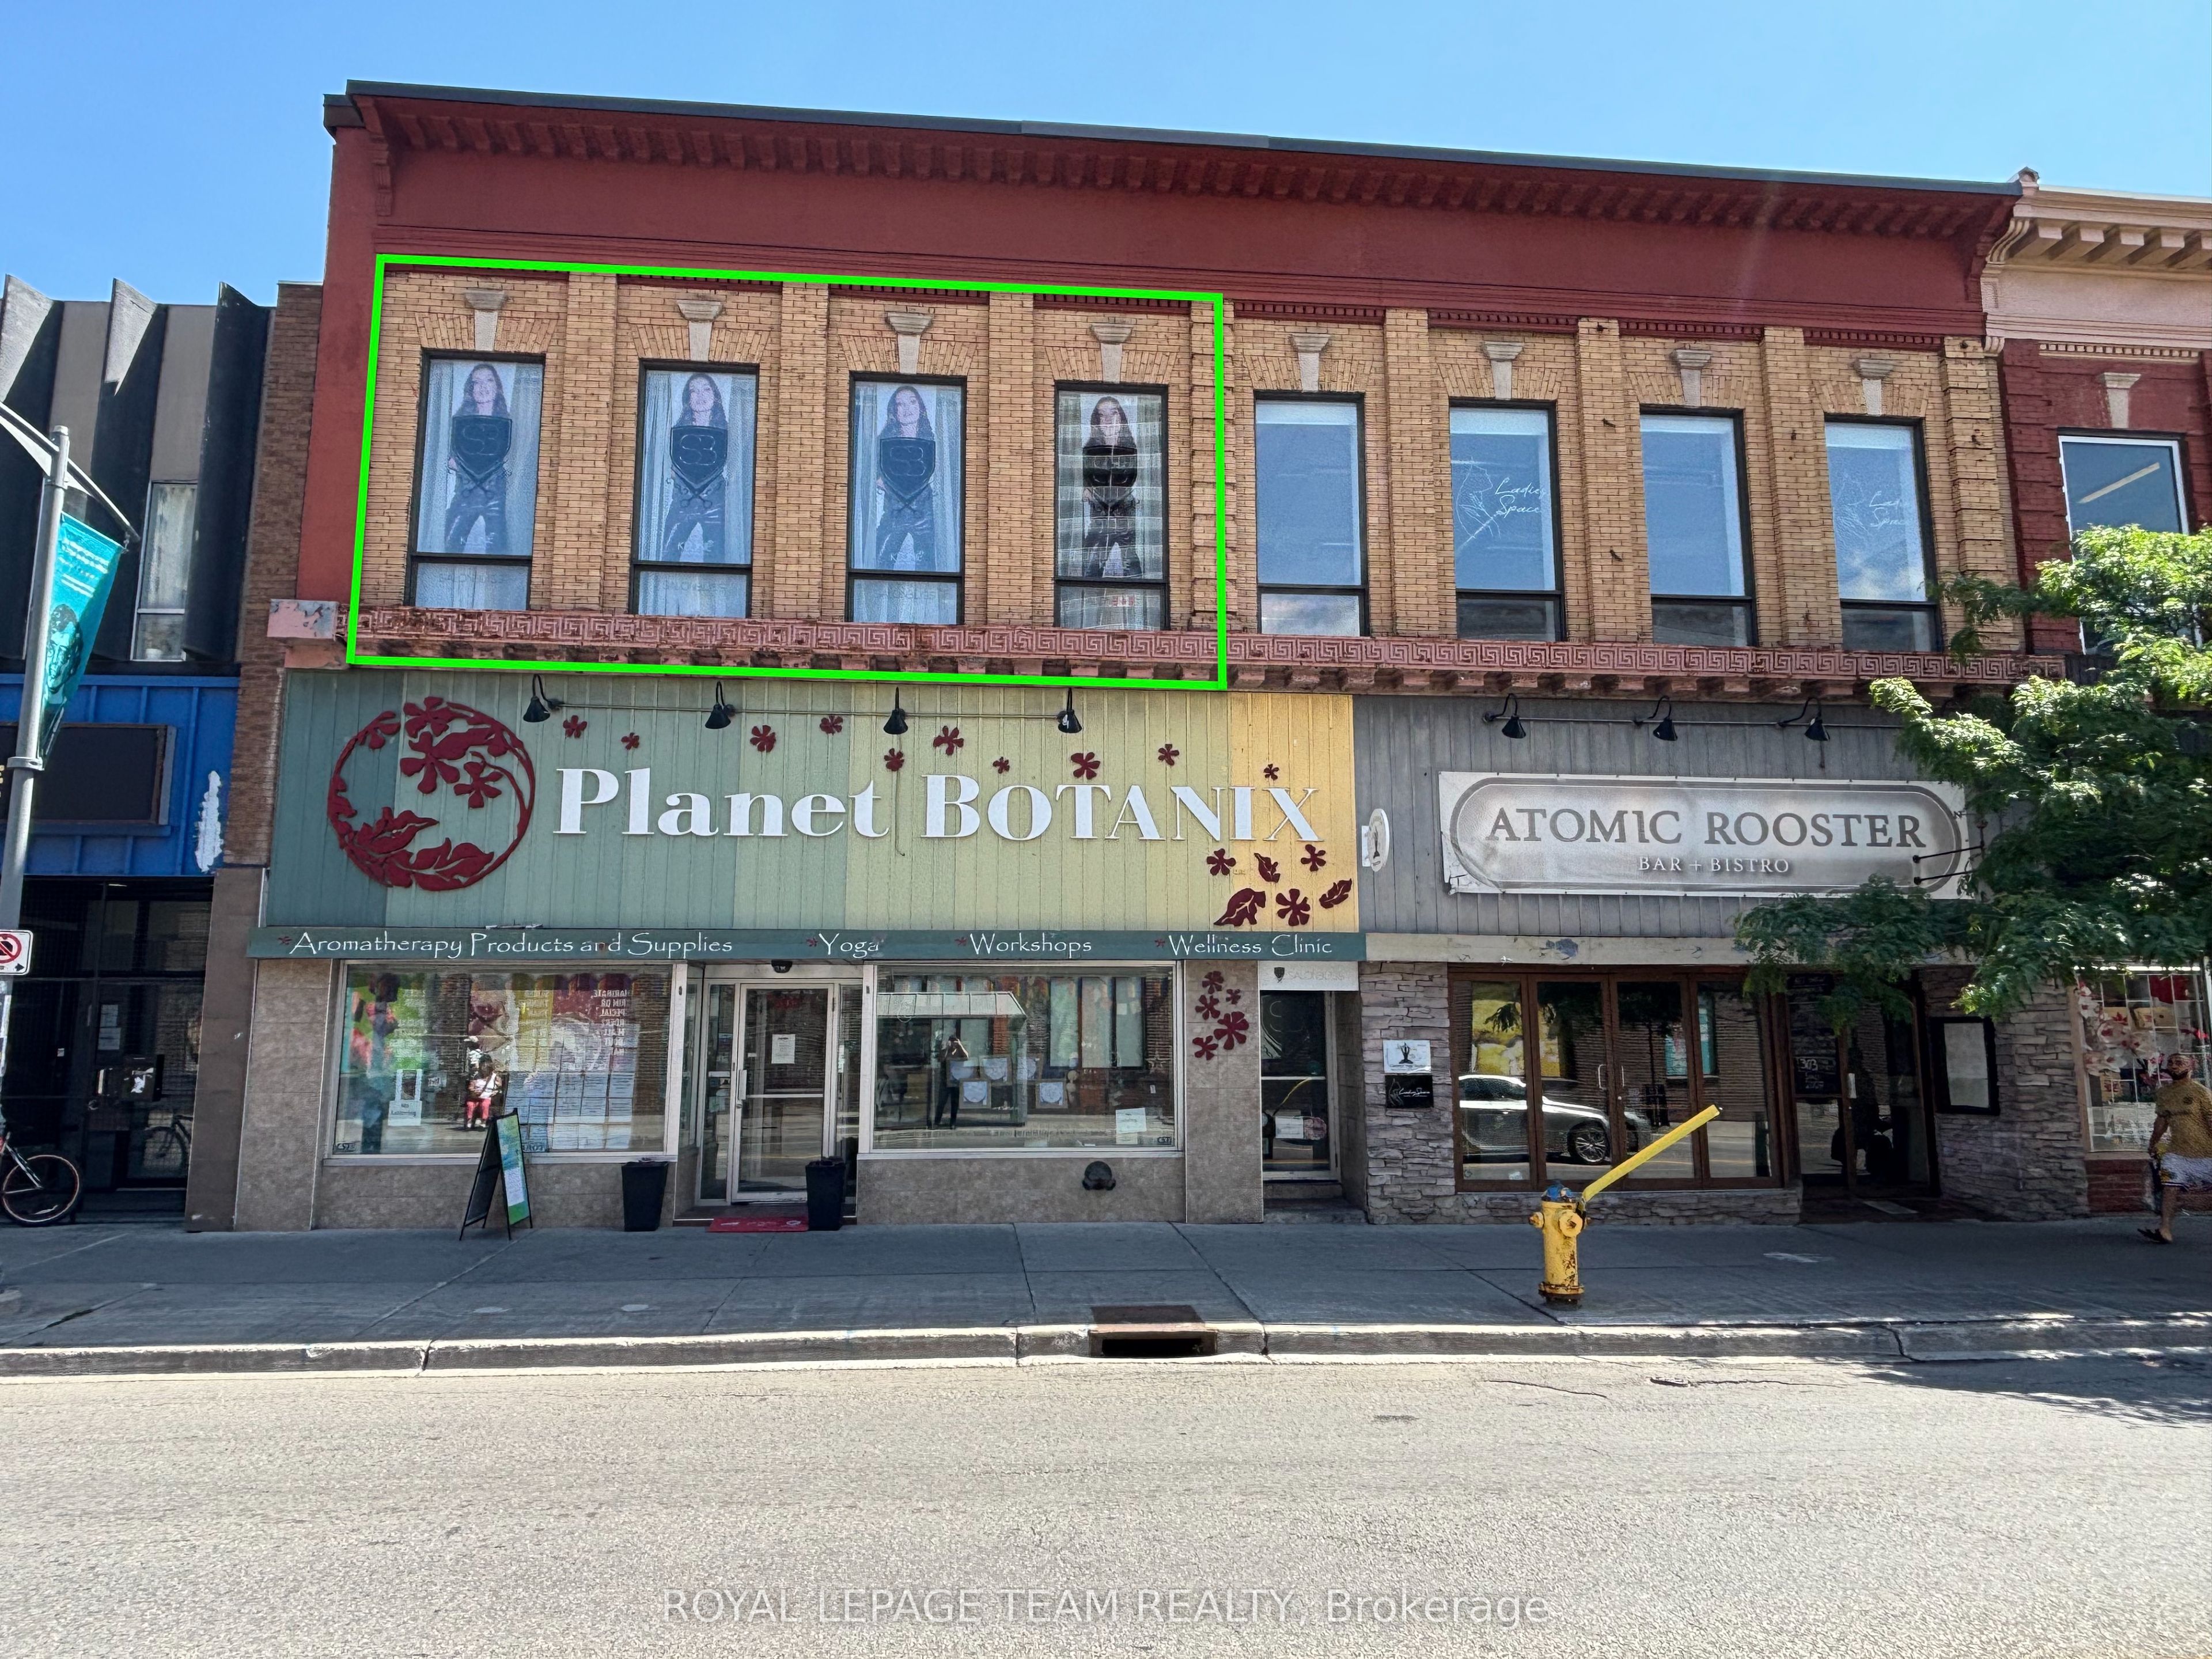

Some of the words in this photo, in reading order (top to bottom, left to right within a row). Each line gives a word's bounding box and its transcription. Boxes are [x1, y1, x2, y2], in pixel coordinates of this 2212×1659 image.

[553, 767, 890, 838] Planet
[920, 774, 1326, 842] BOTANIX
[1484, 806, 1682, 844] ATOMIC
[1704, 811, 1927, 848] ROOSTER
[1638, 856, 1682, 872] BAR
[1710, 858, 1790, 873] BISTRO
[289, 930, 462, 959] Aromatherapy
[470, 931, 574, 957] Products
[580, 931, 622, 952] and
[627, 931, 733, 959] Supplies
[817, 932, 881, 959] Yoga
[969, 932, 1093, 959] Workshops
[1168, 933, 1262, 956] Wellness
[1271, 933, 1333, 957] Clinic
